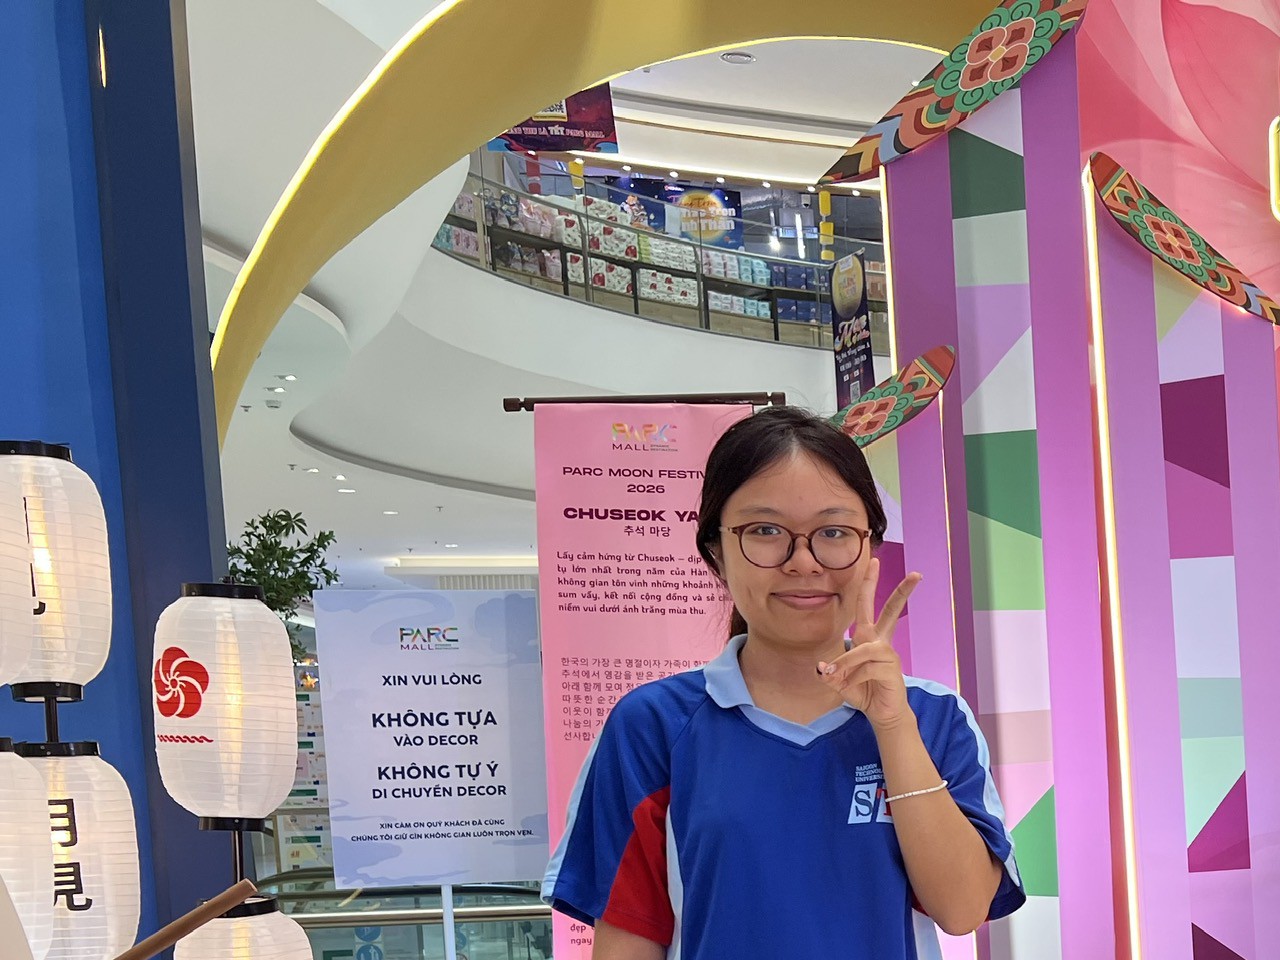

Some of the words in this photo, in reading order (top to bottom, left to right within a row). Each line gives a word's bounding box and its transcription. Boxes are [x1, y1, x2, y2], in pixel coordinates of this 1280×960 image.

[612, 443, 649, 451] MALL
[562, 467, 603, 476] PARC
[609, 469, 653, 477] MOON
[627, 484, 665, 493] 2026
[563, 508, 666, 521] CHUSEOK
[675, 510, 699, 522] YA
[624, 525, 645, 537] 추석
[650, 526, 671, 537] 마당
[557, 551, 574, 561] Lấy
[577, 552, 595, 560] cảm
[598, 553, 621, 562] hứng
[625, 553, 635, 561] từ
[638, 553, 675, 562] Chuseok
[688, 555, 702, 564] dịp
[557, 564, 566, 574] tụ
[572, 564, 586, 573] lớn
[592, 566, 612, 574] nhất
[617, 567, 641, 576] trong
[670, 567, 685, 575] của
[691, 568, 708, 576] Hàn
[557, 577, 586, 587] không
[589, 579, 609, 588] gian
[612, 579, 626, 587] tôn
[629, 579, 648, 587] vinh
[651, 580, 680, 590] những
[683, 580, 713, 589] khoảnh
[640, 593, 661, 602] cộng
[599, 604, 620, 613] dưới
[623, 605, 639, 613] ánh
[642, 605, 666, 615] trăng
[690, 607, 706, 615] thu.
[400, 627, 458, 642] PARC
[561, 657, 589, 667] 한국의
[592, 658, 610, 667] 가장
[613, 659, 621, 667] 큰
[625, 659, 661, 668] 명절이자
[664, 660, 690, 669] 가족이
[382, 674, 408, 686] XIN
[411, 674, 437, 686] VUI
[441, 672, 482, 685] LÒNG
[562, 669, 600, 679] 추석에서
[604, 671, 632, 680] 영감을
[636, 672, 654, 680] 받은
[562, 682, 580, 691] 아래
[583, 682, 601, 692] 함께
[605, 683, 622, 692] 모여
[562, 695, 593, 704] 따뜻한
[563, 707, 592, 716] 이웃이
[372, 709, 449, 728] KHÔNG
[454, 709, 497, 730] TỰA
[563, 719, 592, 728] 나눔의
[393, 734, 424, 746] VÀO
[428, 735, 478, 746] DECOR
[564, 732, 596, 741] 선사합
[377, 763, 450, 780] KHÔNG
[455, 762, 481, 781] TỰ
[487, 761, 499, 777] Ý
[855, 768, 883, 776] TECHNOL
[372, 789, 387, 799] DI
[391, 784, 452, 798] CHUYỂN
[457, 785, 507, 797] DECOR
[427, 820, 442, 828] QUÝ
[444, 819, 470, 827] KHÁCH
[484, 818, 505, 826] CÙNG
[351, 834, 378, 842] CHÚNG
[380, 833, 393, 841] TÔI
[409, 832, 423, 840] GÌN
[424, 831, 452, 839] KHÔNG
[570, 923, 586, 933] đẹp
